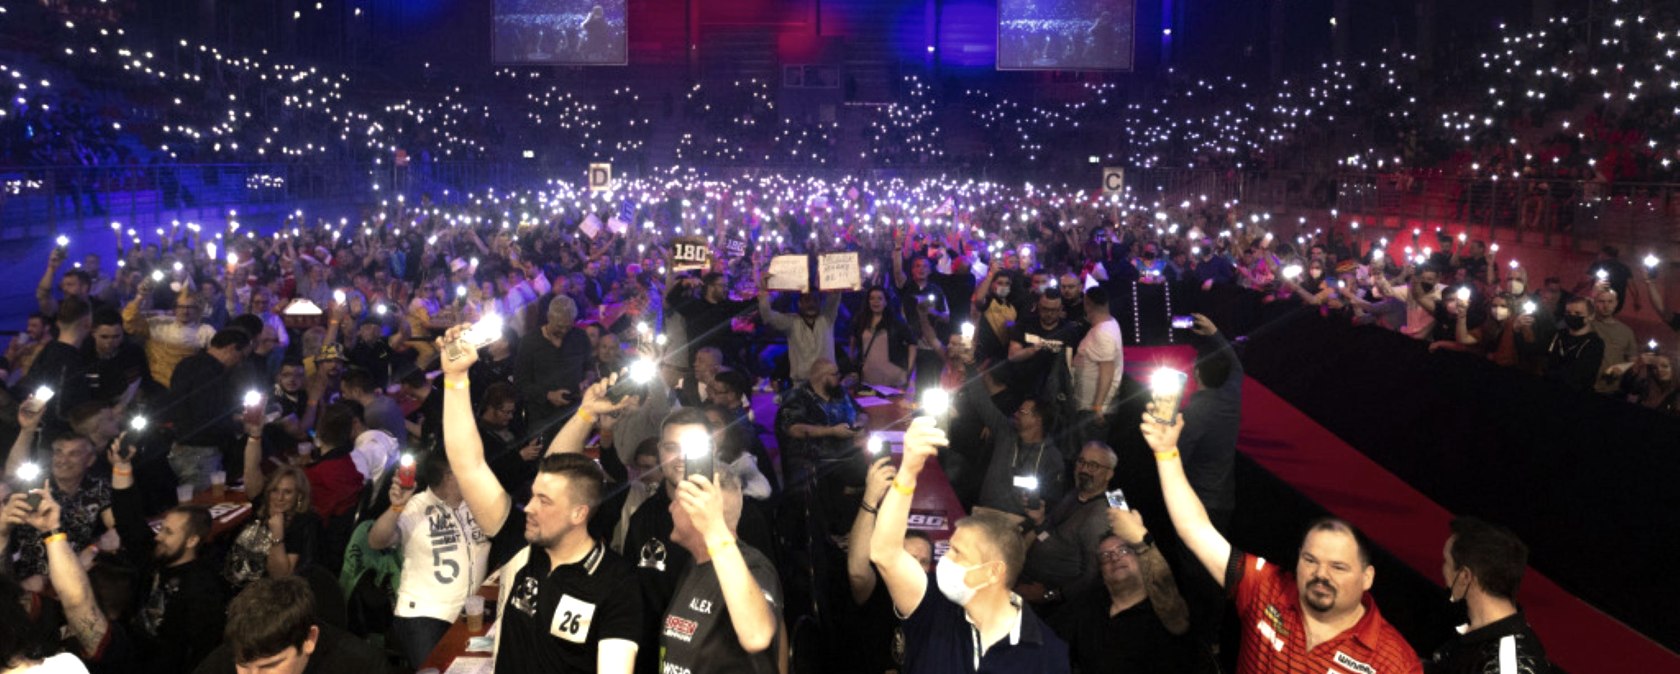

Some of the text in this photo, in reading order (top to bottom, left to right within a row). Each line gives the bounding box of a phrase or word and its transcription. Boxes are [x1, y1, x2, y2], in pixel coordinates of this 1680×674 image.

[592, 168, 606, 187] D
[1106, 173, 1121, 190] C
[674, 243, 705, 261] 180
[908, 514, 944, 525] 80
[432, 544, 460, 584] 5
[689, 597, 713, 614] ALEX
[558, 610, 582, 635] 26
